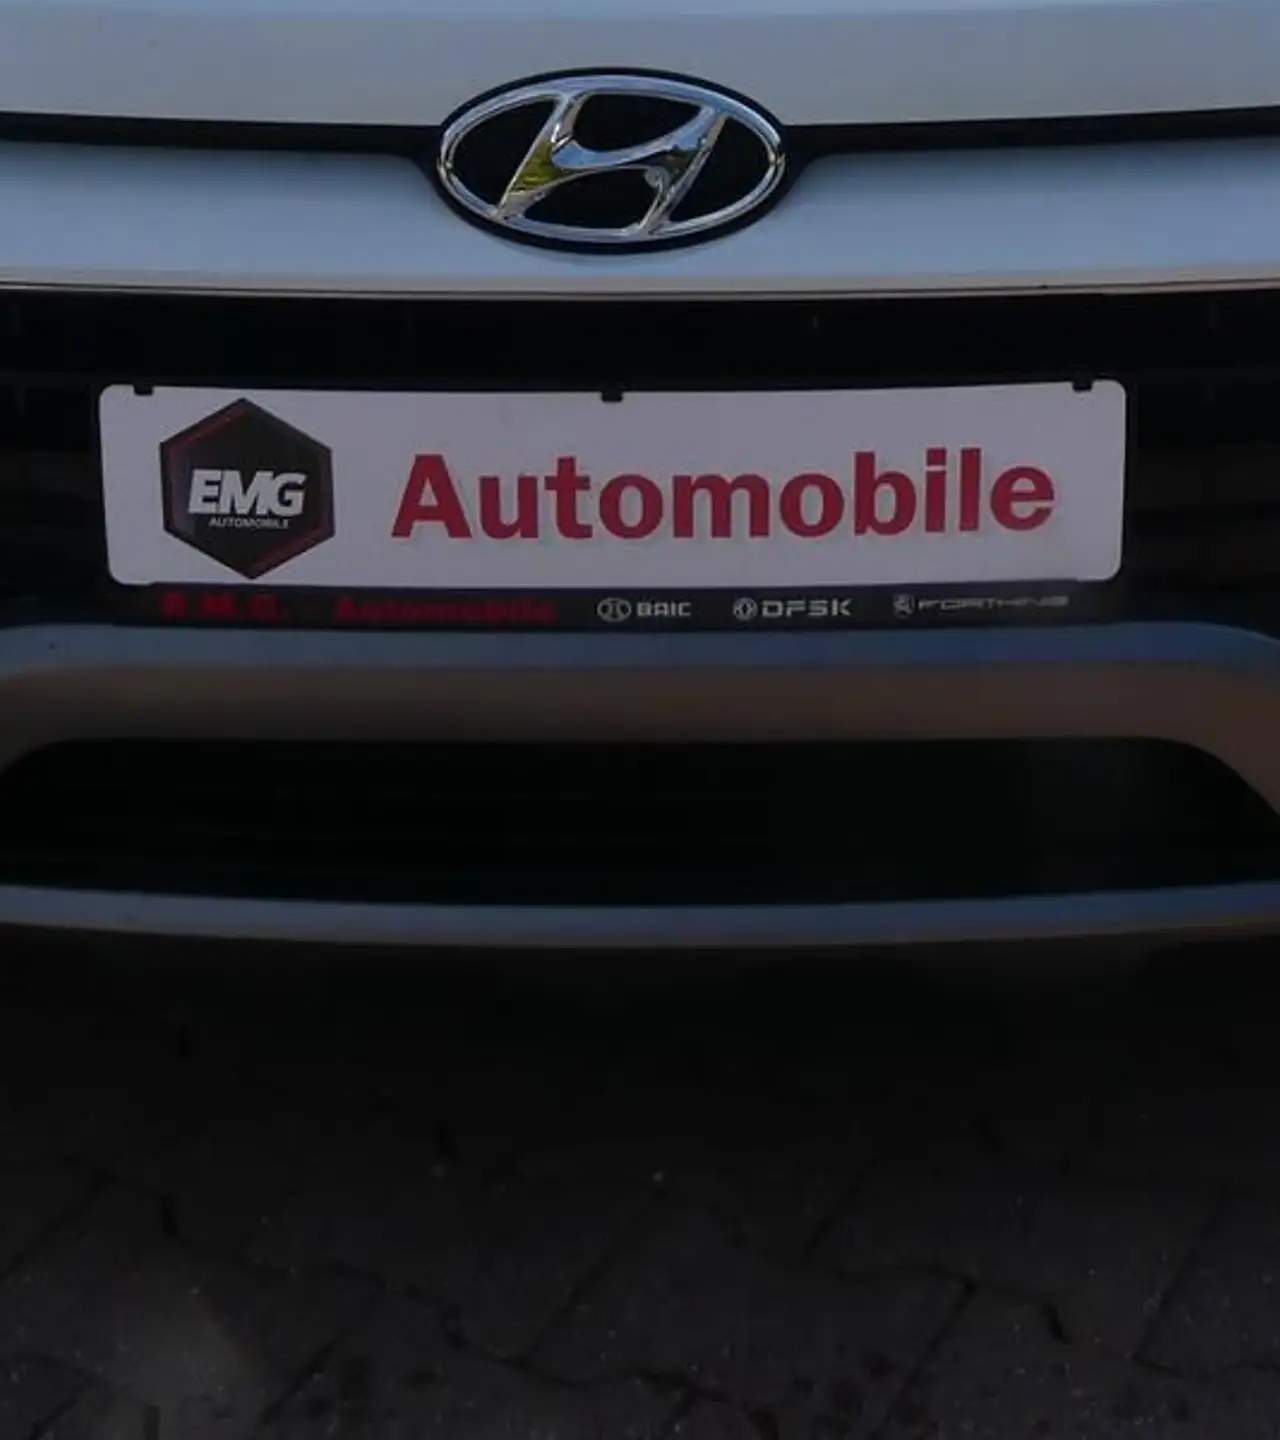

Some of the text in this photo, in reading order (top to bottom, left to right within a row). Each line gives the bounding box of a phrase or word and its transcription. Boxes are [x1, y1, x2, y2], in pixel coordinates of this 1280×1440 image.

[188, 468, 308, 517] EMG
[391, 447, 1055, 539] Automobile
[636, 601, 693, 618] BAIC
[761, 598, 852, 618] DFSK
